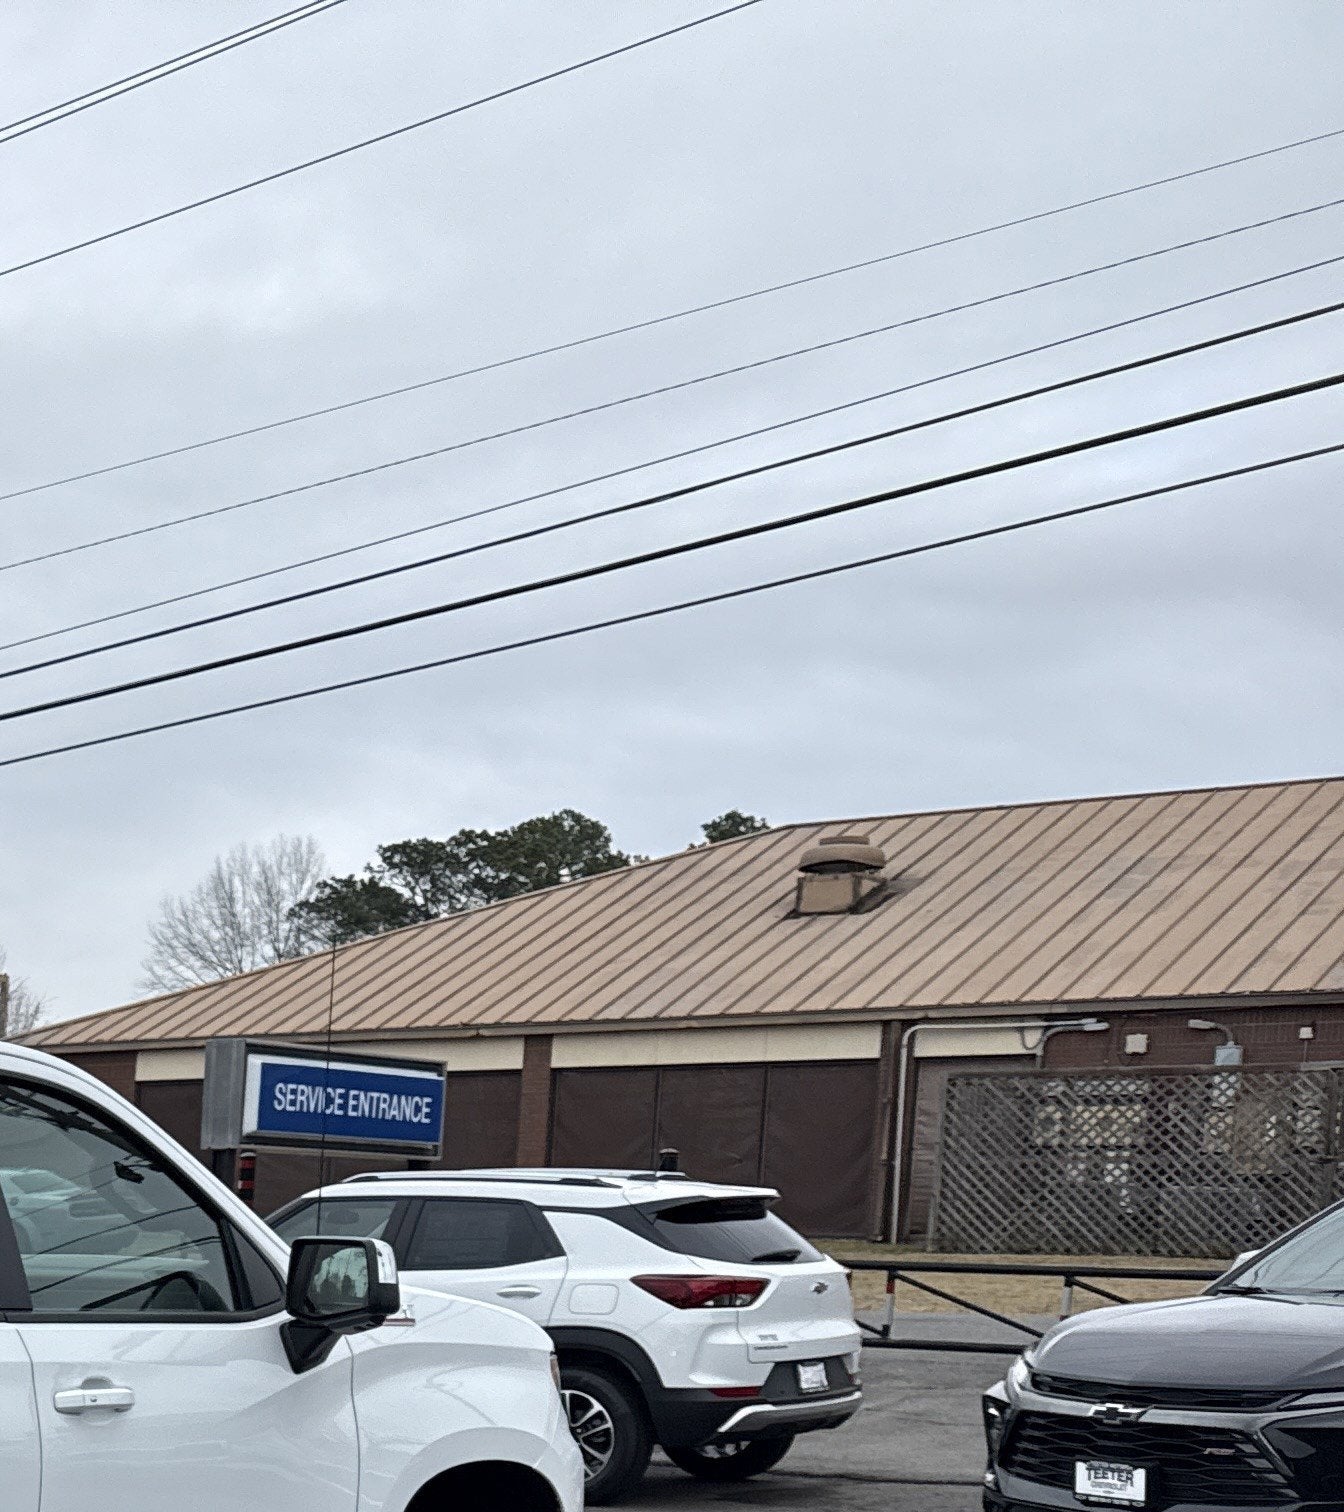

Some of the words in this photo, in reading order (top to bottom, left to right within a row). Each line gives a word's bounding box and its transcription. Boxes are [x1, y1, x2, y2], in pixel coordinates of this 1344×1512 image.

[273, 1082, 345, 1116] SERVICE
[347, 1089, 432, 1124] ENTRANCE
[1087, 1466, 1134, 1487] TEETER
